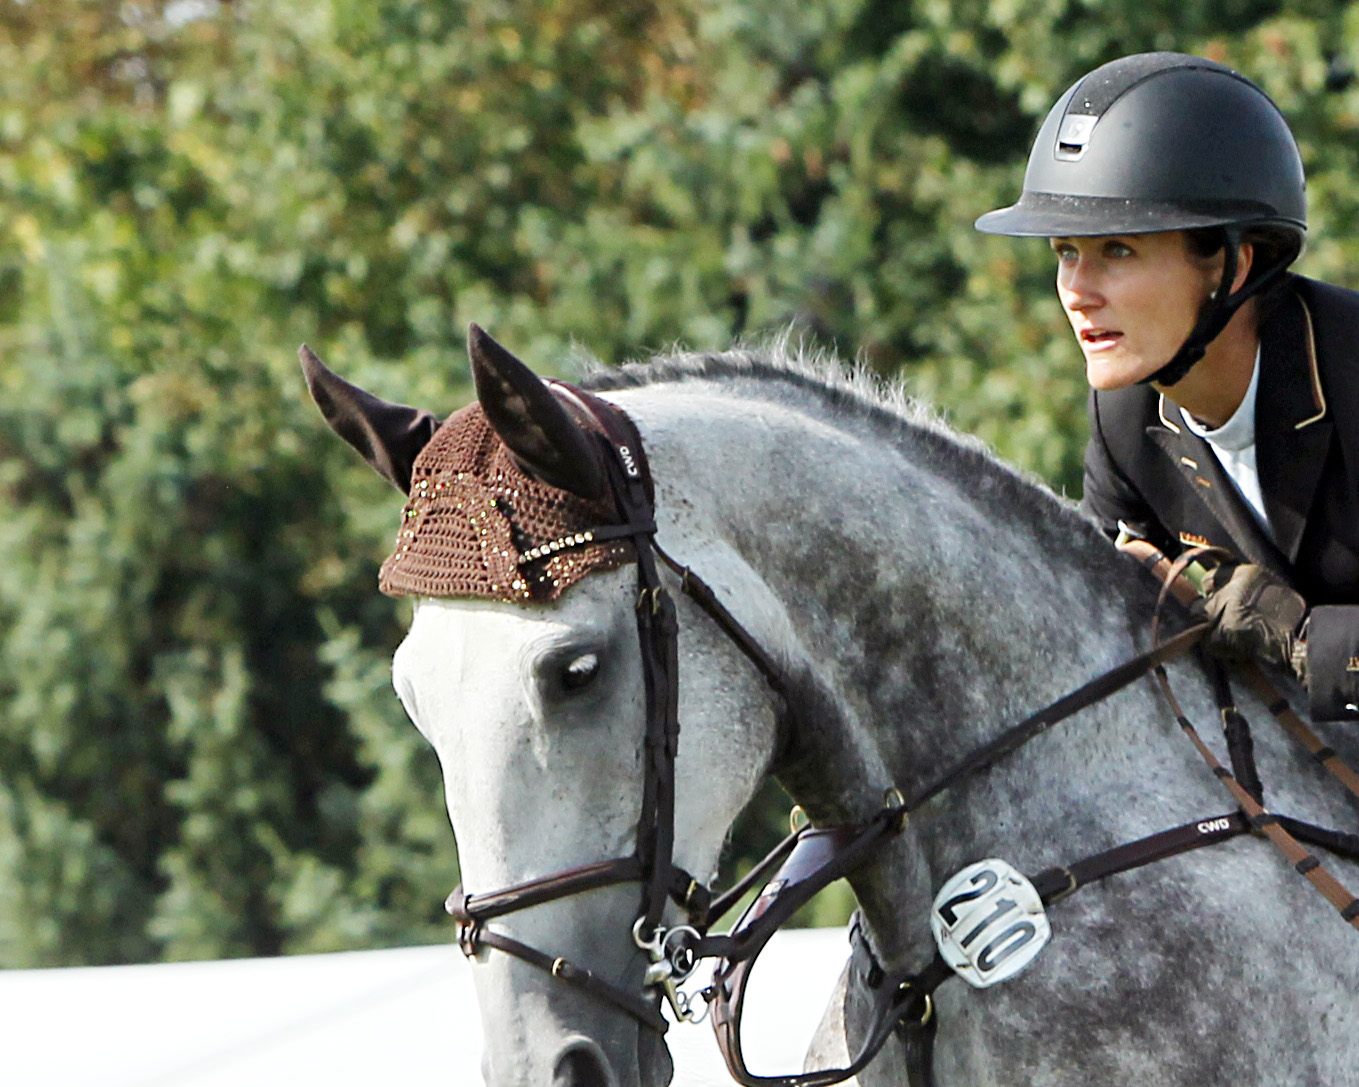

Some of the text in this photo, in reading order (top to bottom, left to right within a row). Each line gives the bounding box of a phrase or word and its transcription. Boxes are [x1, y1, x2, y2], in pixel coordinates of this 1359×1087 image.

[619, 445, 638, 476] CWD
[1197, 818, 1230, 834] CWD
[938, 869, 1036, 972] 210
